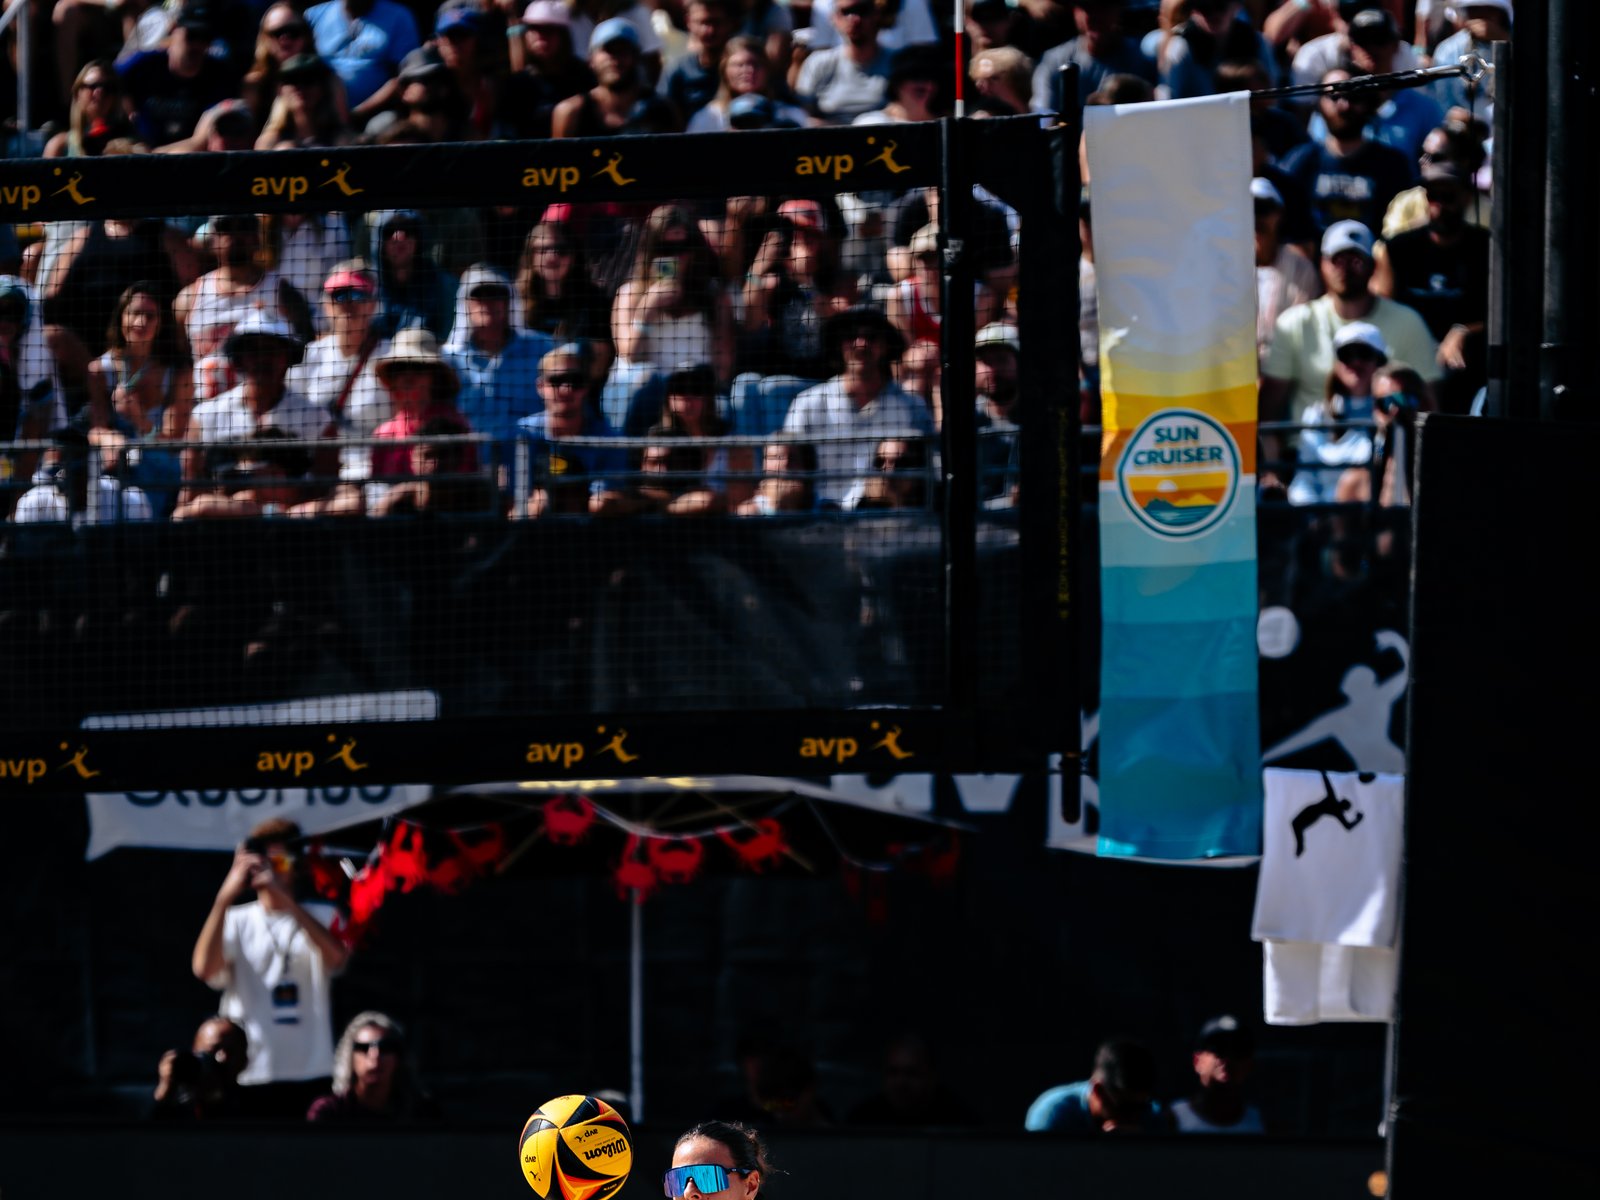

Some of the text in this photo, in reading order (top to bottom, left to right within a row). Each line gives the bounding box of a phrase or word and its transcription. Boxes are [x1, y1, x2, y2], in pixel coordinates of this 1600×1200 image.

[522, 166, 580, 192] avp
[795, 154, 854, 180] avp
[0, 185, 41, 210] vp
[251, 176, 308, 202] avp
[1154, 426, 1198, 443] SUN
[1133, 446, 1223, 466] CRUISER
[526, 742, 584, 768] avp
[799, 737, 858, 763] avp
[257, 751, 314, 776] avp
[584, 1129, 598, 1137] avp
[583, 1138, 626, 1160] Wilson
